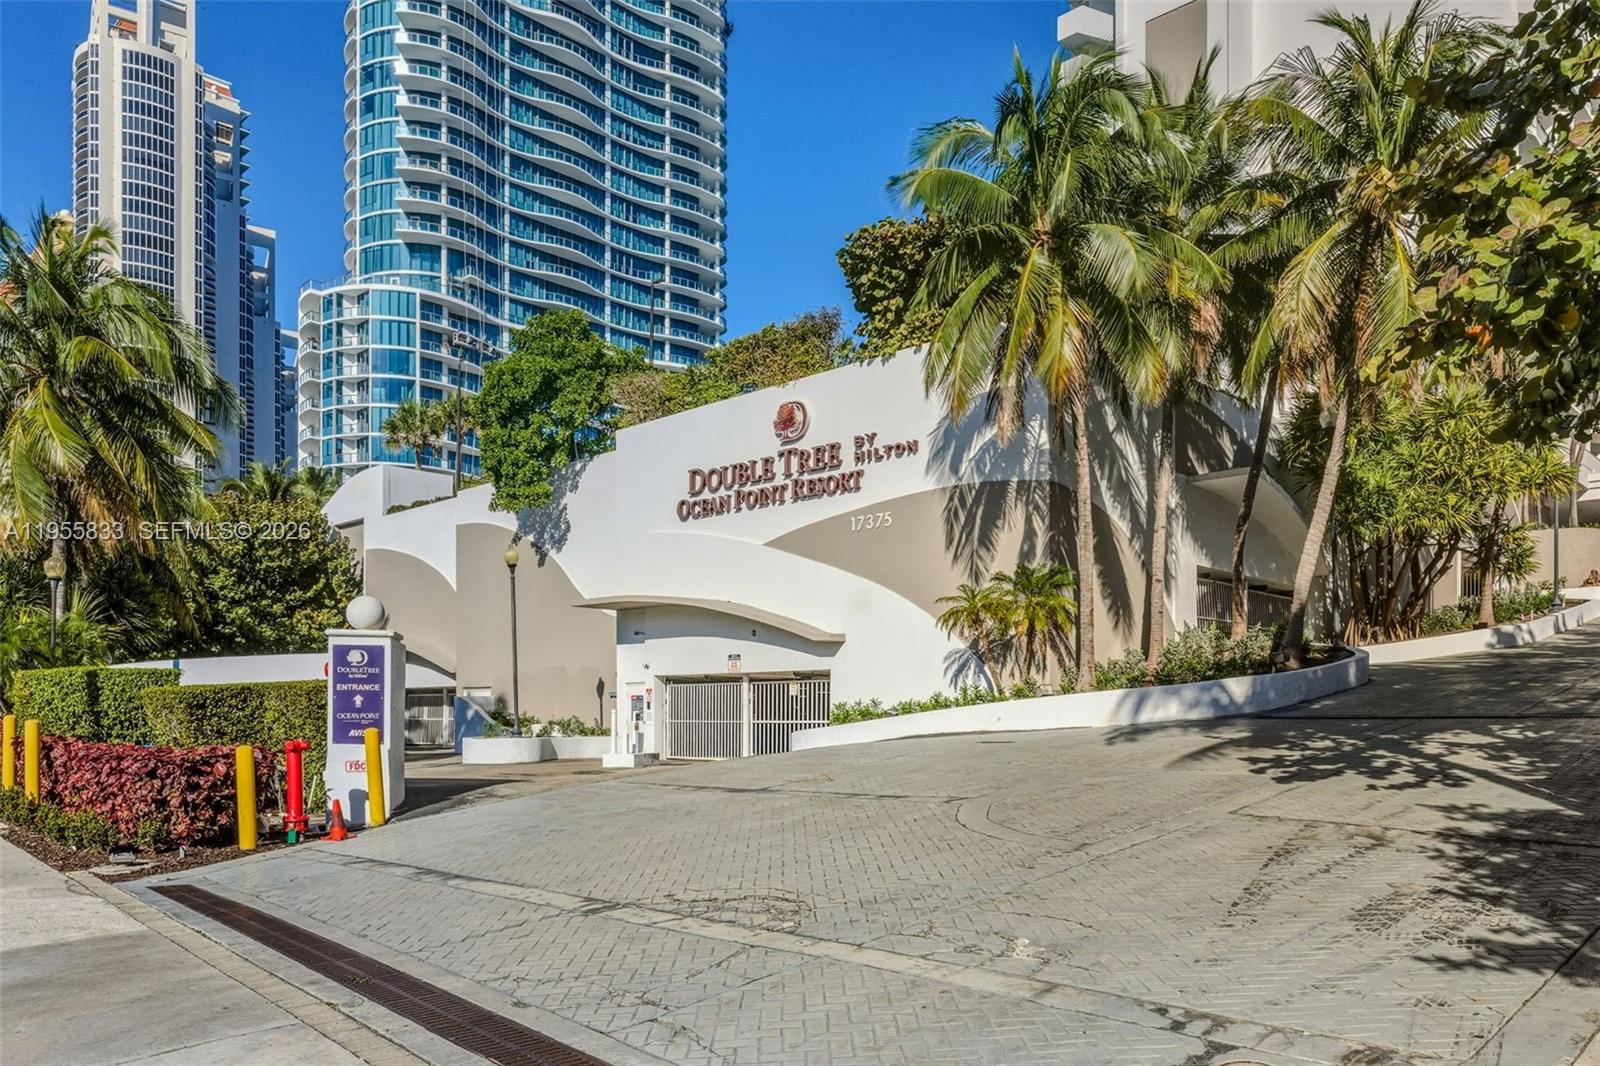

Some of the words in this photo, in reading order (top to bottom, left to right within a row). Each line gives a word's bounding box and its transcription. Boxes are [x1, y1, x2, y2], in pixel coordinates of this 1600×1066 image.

[854, 432, 878, 450] BY
[854, 439, 920, 467] HILTON
[688, 456, 776, 498] DOUBLE
[778, 442, 843, 479] TREE
[676, 494, 732, 522] OCEAN
[733, 483, 789, 513] POINT
[790, 469, 865, 503] RESORT
[850, 511, 893, 533] 17375
[336, 683, 380, 691] ENTRANCE
[349, 762, 367, 770] FDC
